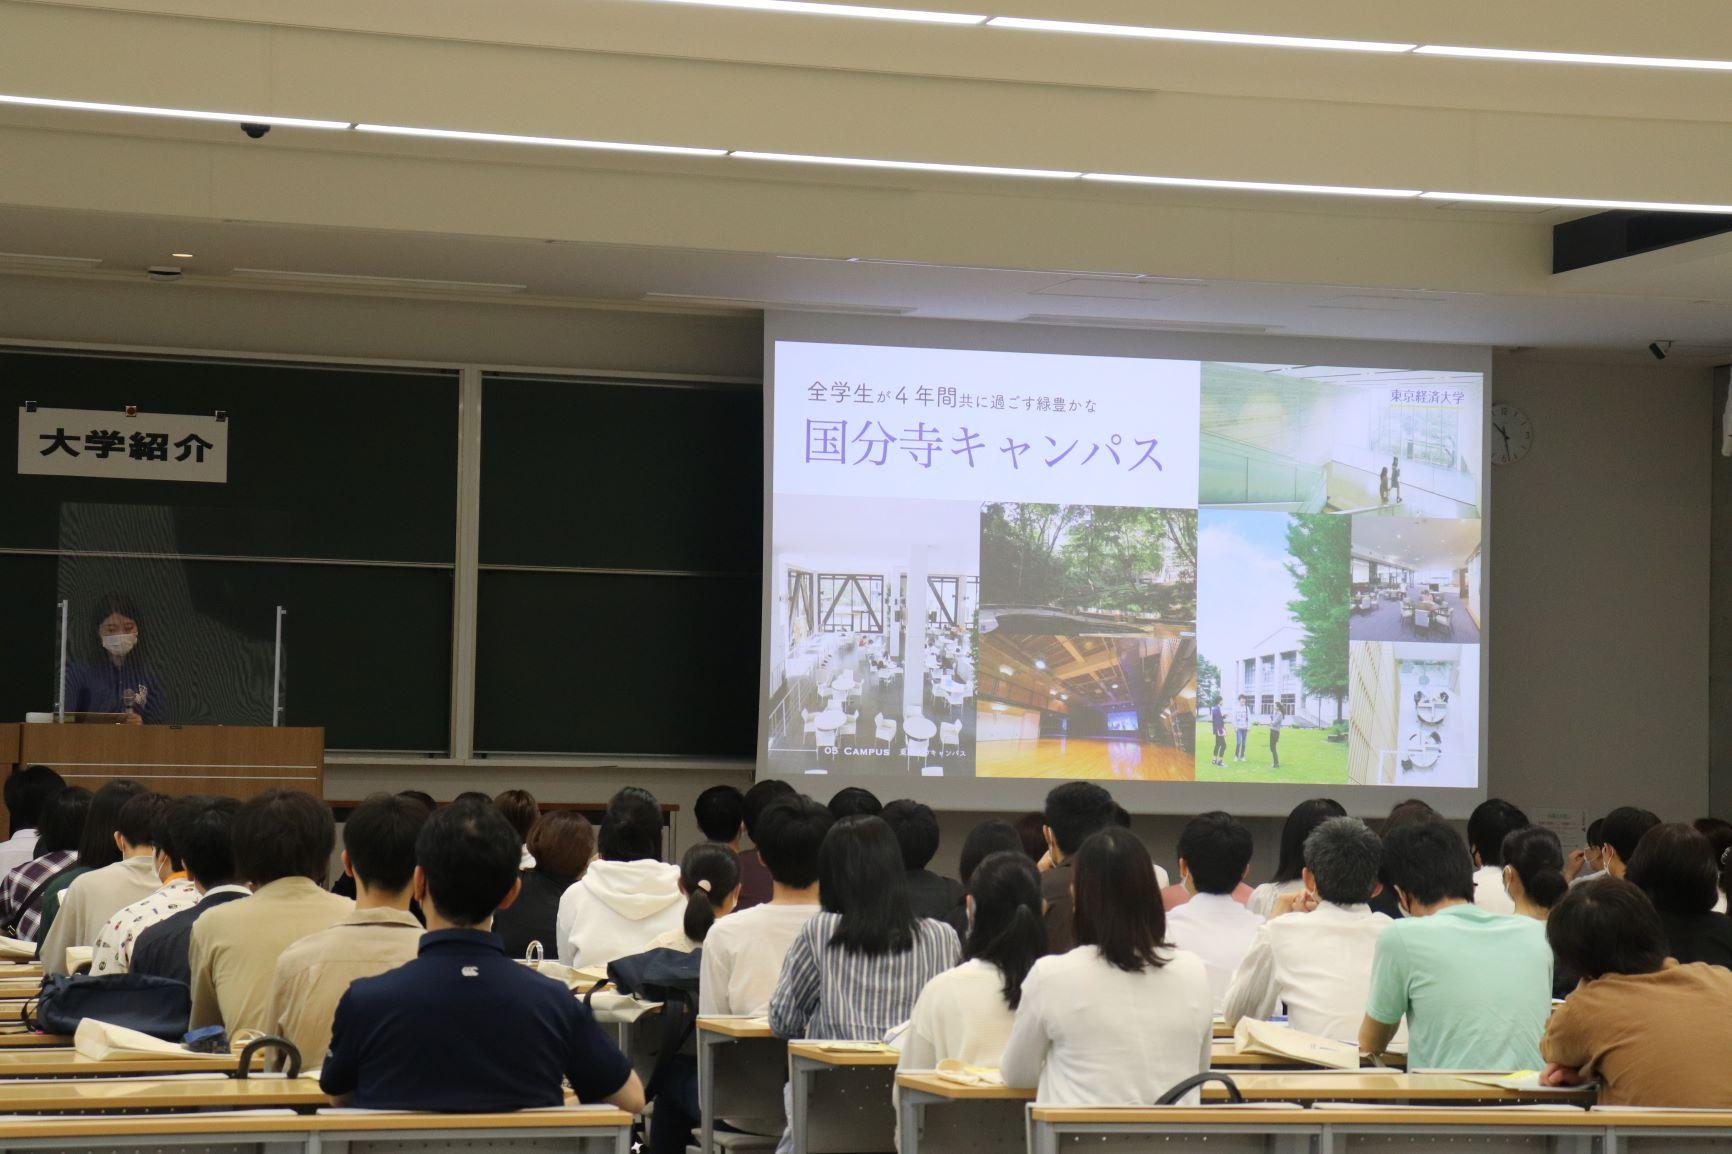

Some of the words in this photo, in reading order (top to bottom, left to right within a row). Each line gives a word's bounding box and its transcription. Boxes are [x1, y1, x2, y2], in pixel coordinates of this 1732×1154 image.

[1391, 389, 1465, 405] 東京経済大学
[39, 427, 214, 463] 大学紹介
[805, 418, 1164, 472] 国分寺キャンパス
[844, 747, 890, 757] CAMPUS
